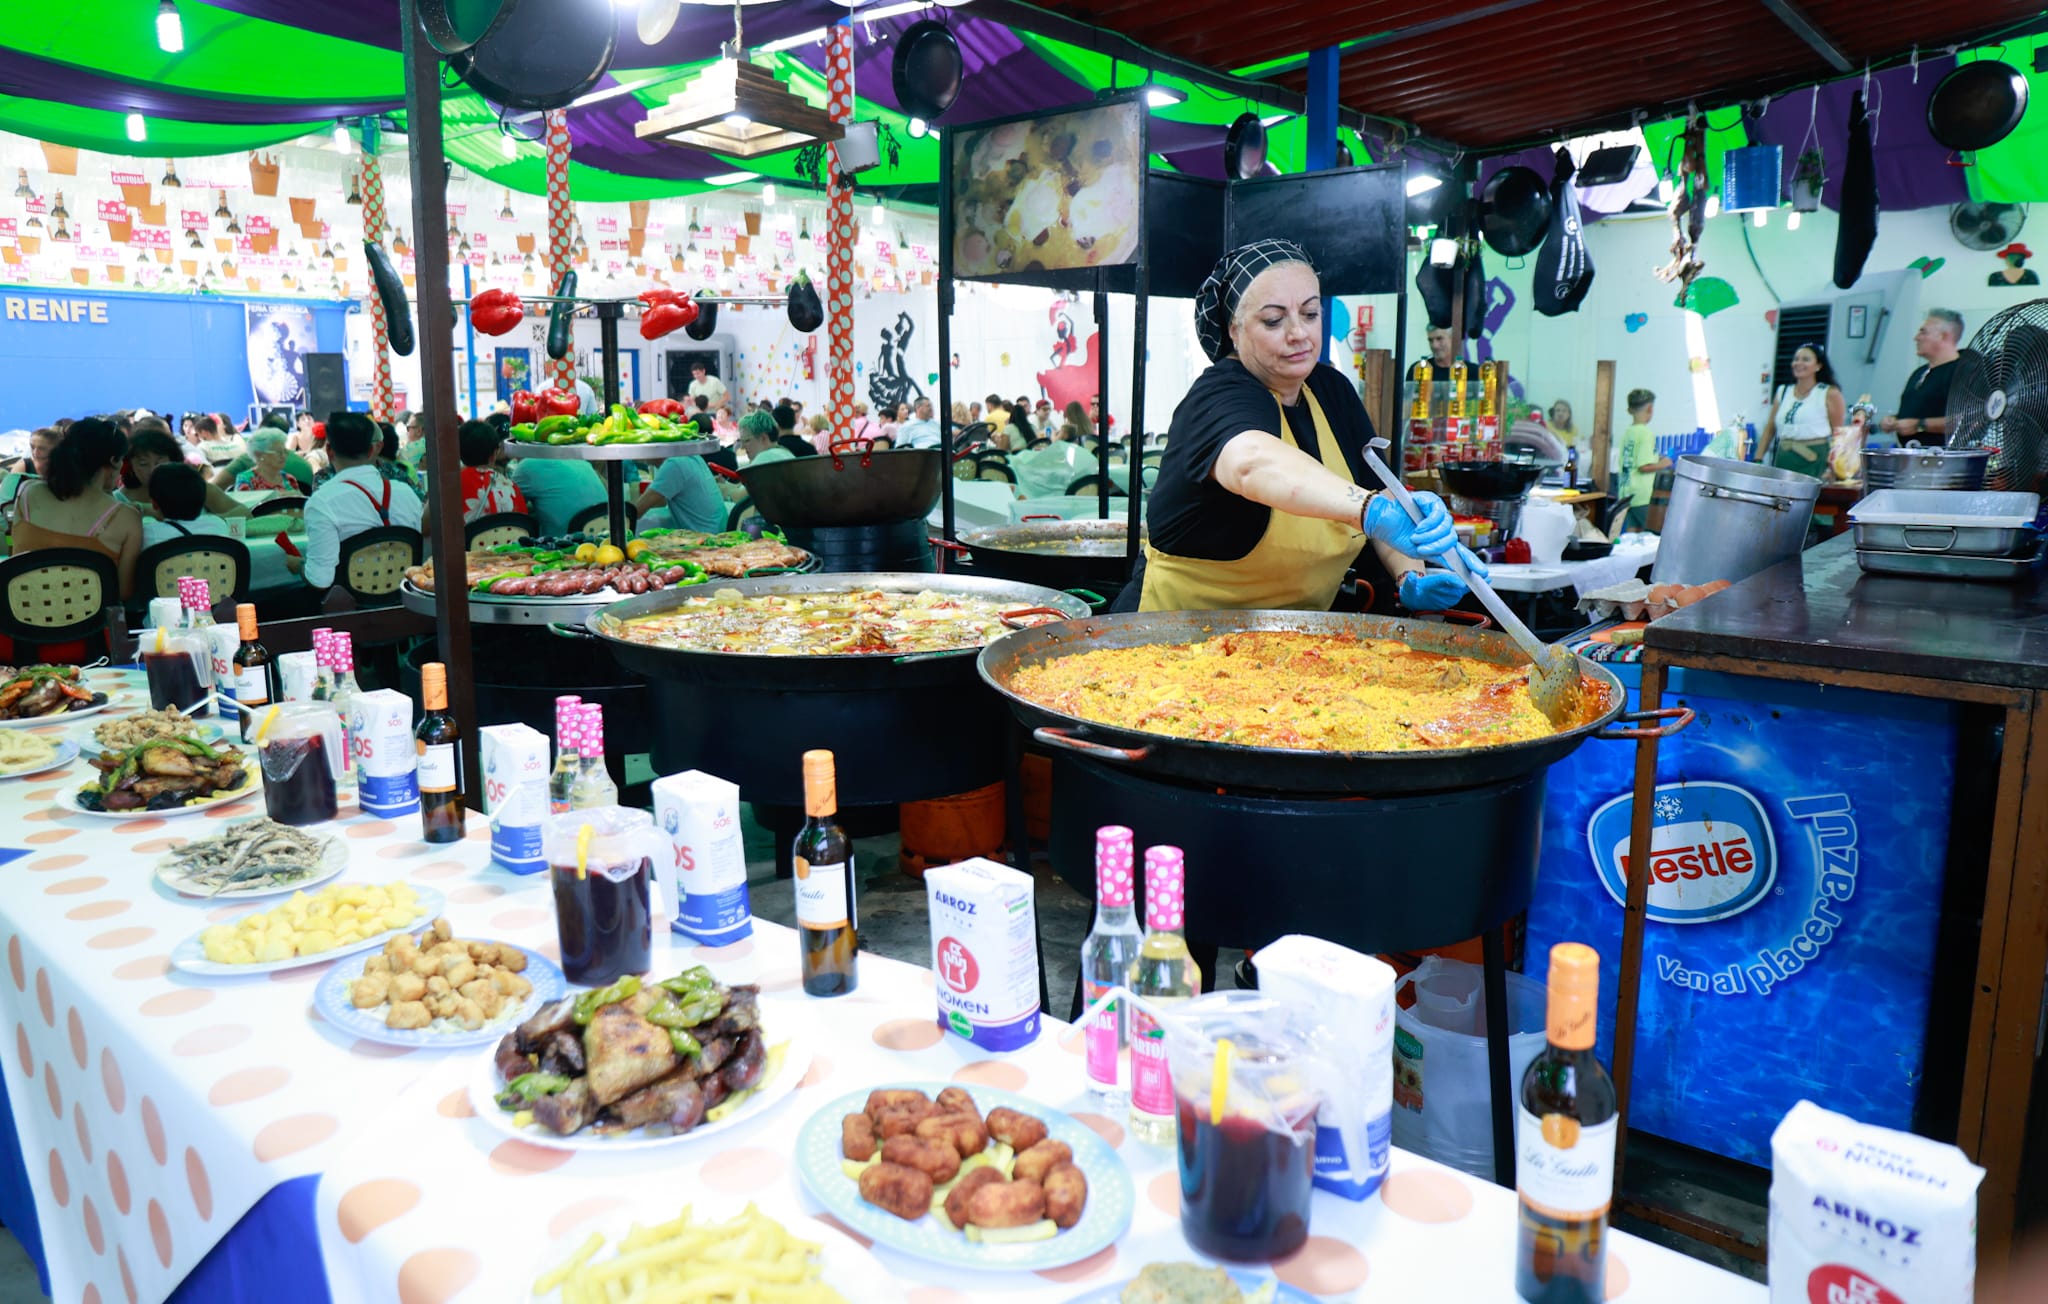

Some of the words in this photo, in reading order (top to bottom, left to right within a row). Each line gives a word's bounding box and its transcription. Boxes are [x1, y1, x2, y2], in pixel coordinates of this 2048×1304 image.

[5, 297, 109, 323] RENFE
[211, 656, 228, 674] OS
[354, 737, 373, 758] OS
[484, 776, 507, 803] OS
[713, 816, 732, 830] SOS
[672, 843, 696, 871] OS
[1784, 792, 1858, 903] azul
[935, 889, 978, 915] ARROZ
[1747, 897, 1842, 995] placer
[1657, 954, 1708, 991] Ven
[1713, 963, 1747, 994] al
[1813, 1195, 1922, 1247] ARROZ
